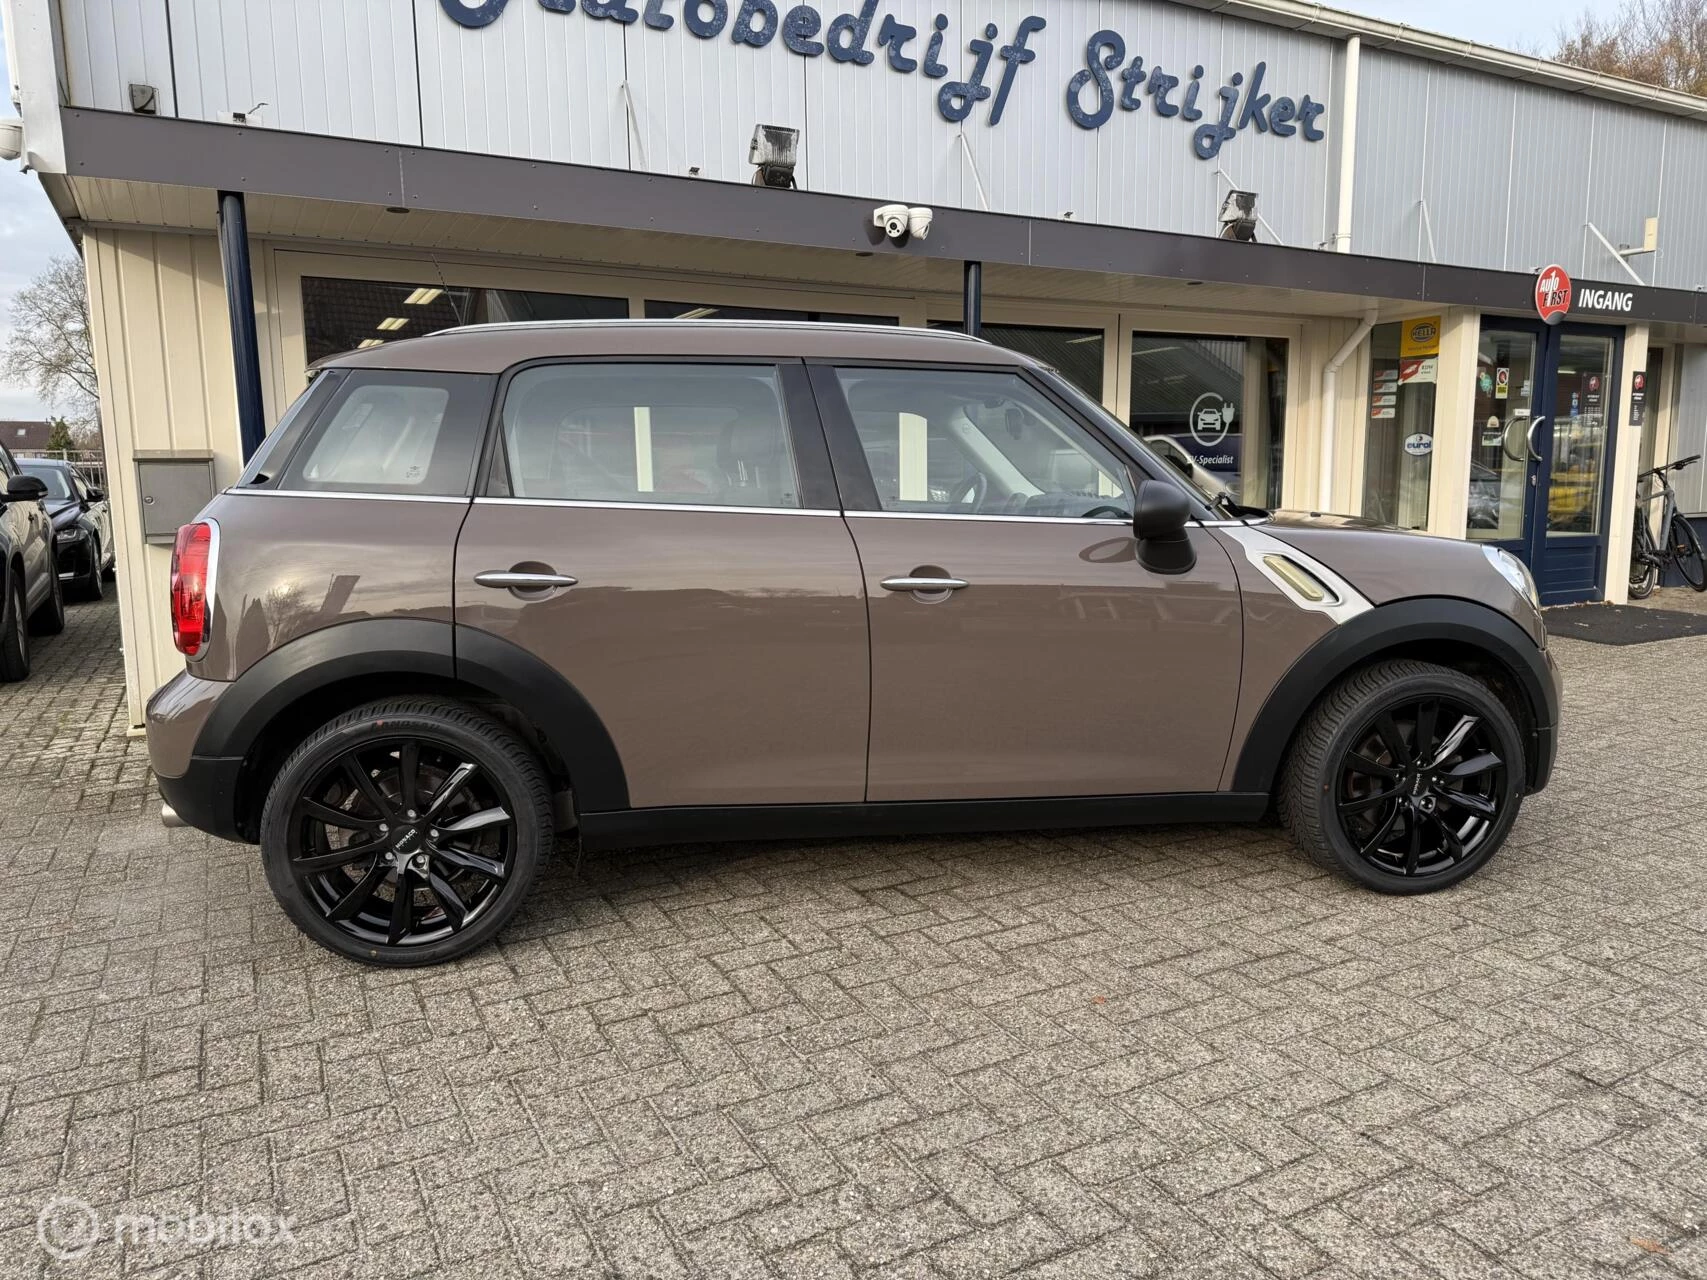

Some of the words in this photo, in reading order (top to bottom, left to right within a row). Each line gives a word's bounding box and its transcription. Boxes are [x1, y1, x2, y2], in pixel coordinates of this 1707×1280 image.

[440, 0, 1046, 125] obedrijf
[1066, 29, 1324, 160] Strijker
[1578, 288, 1634, 311] INGANG
[1407, 440, 1432, 449] eurol
